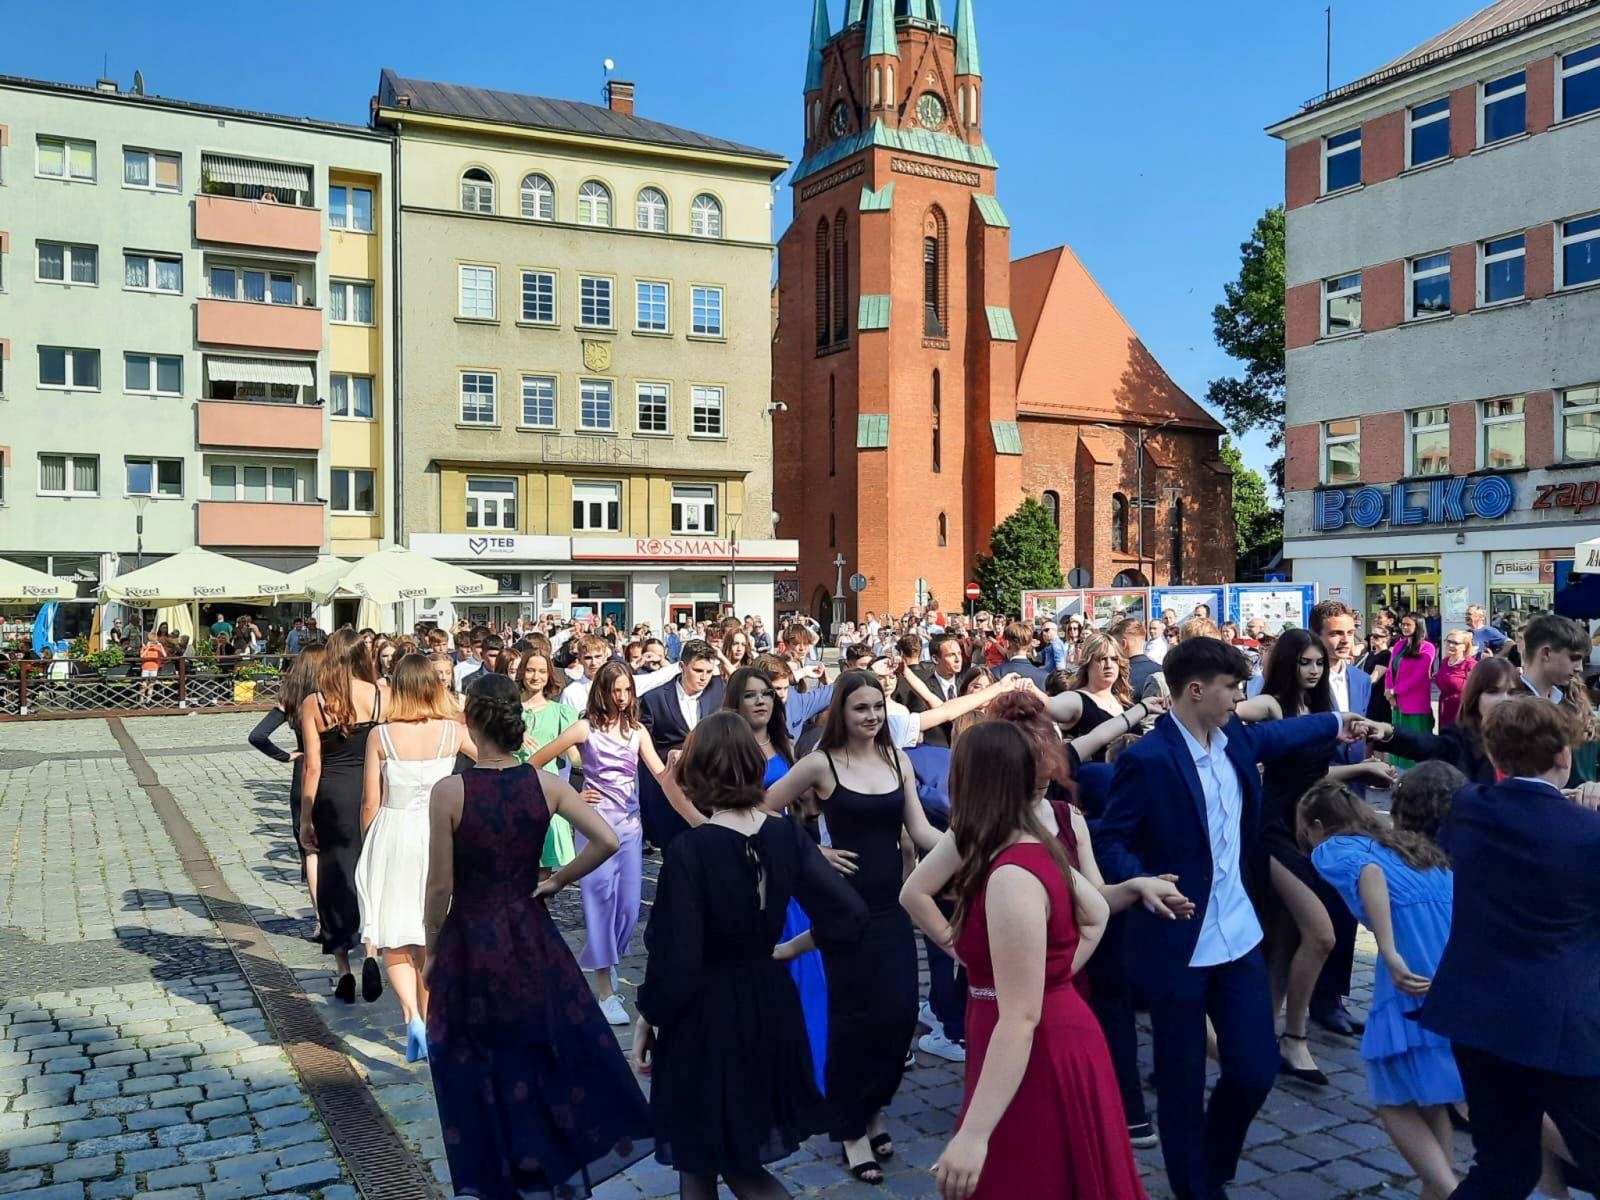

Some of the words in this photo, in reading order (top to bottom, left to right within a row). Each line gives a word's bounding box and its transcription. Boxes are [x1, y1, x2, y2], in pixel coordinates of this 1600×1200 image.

[1313, 475, 1514, 531] BOLKO
[489, 538, 515, 548] TEB
[635, 539, 740, 555] ROSSMANN
[22, 586, 59, 596] Kozel
[125, 586, 160, 597] Kozel
[192, 585, 226, 596] Kozel
[257, 583, 290, 594] Kozel
[398, 587, 428, 598] Kozel
[455, 584, 484, 594] Kozel
